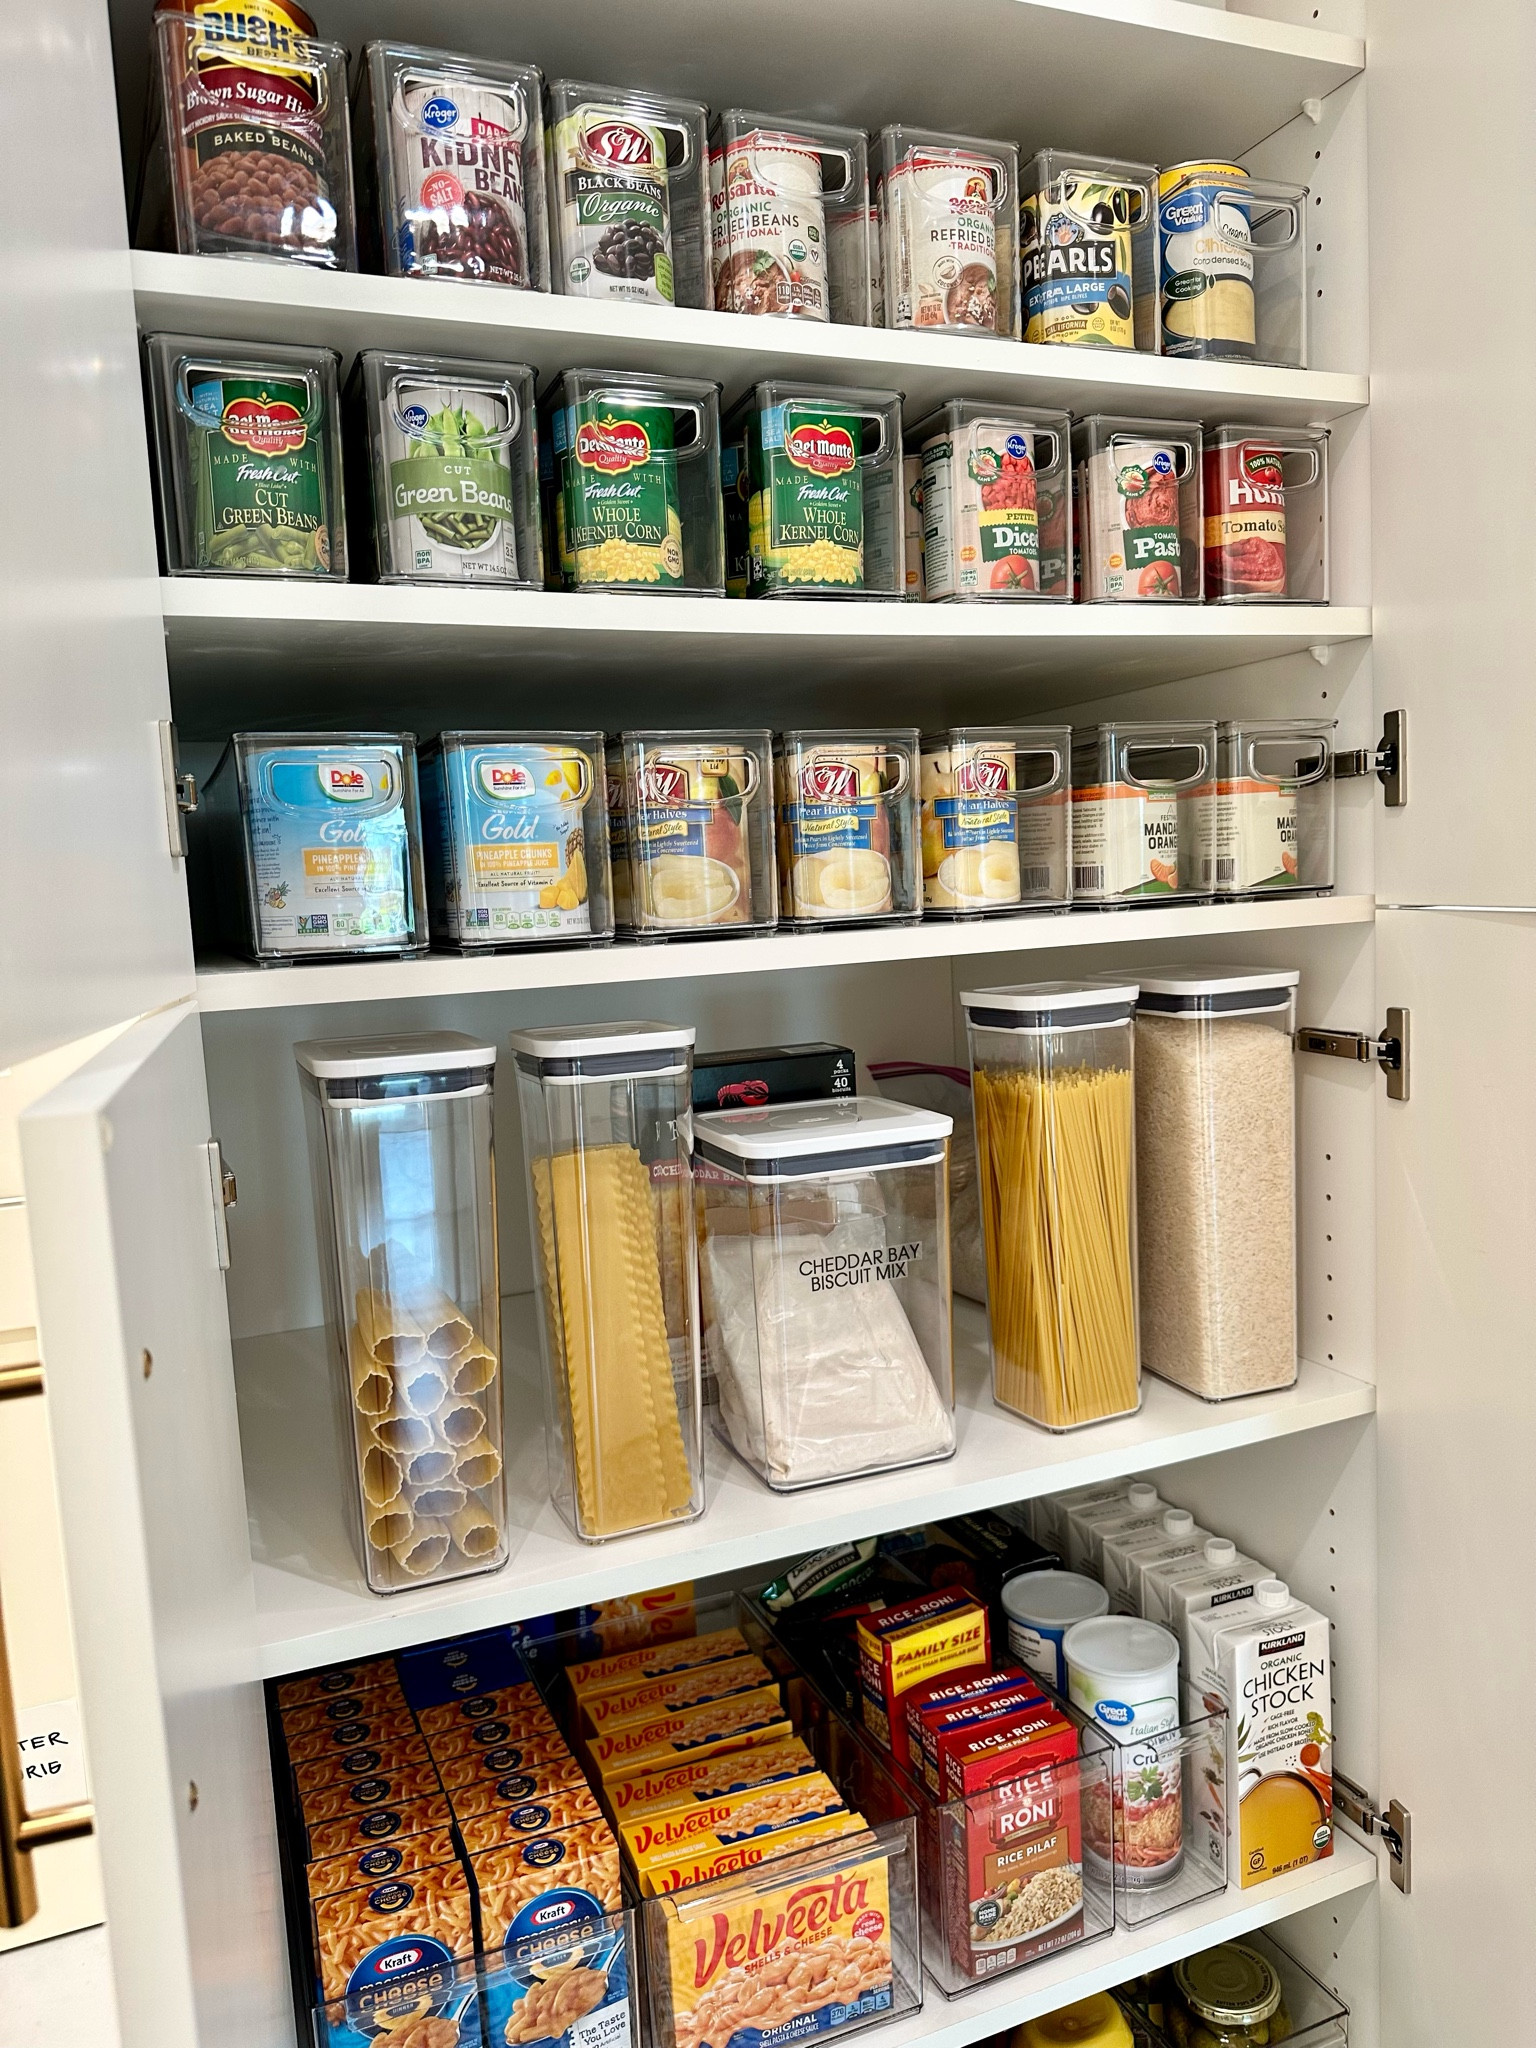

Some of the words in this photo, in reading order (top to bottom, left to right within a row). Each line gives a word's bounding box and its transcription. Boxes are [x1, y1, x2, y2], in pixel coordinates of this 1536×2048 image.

[236, 82, 284, 104] Sugar
[424, 103, 457, 124] Kroger
[214, 131, 266, 147] BAKED
[271, 134, 315, 166] BEANS
[420, 136, 522, 184] KIDNEY
[432, 179, 446, 190] NO
[577, 176, 623, 191] BLACK
[626, 180, 662, 201] BEANS
[430, 187, 454, 207] SALT
[582, 191, 660, 222] Organic
[1165, 201, 1204, 220] Great
[752, 213, 800, 228] BEANS
[930, 228, 985, 244] REFRIED
[1065, 282, 1106, 294] LARGE
[200, 403, 216, 412] SEA
[252, 434, 284, 447] Quality
[1007, 439, 1027, 456] Kroger
[817, 440, 852, 459] Monte
[213, 453, 249, 465] MADE
[289, 457, 317, 473] WITH
[598, 454, 628, 465] Quality
[236, 463, 273, 482] Fresh
[444, 465, 472, 476] CUT
[632, 472, 662, 485] WITH
[775, 476, 809, 487] MADE
[255, 488, 289, 508] CUT
[395, 482, 458, 508] Green
[460, 479, 513, 514] Beans
[584, 482, 616, 502] Fresh
[796, 484, 827, 502] Fresh
[222, 506, 274, 525] GREEN
[276, 507, 318, 530] BEANS
[592, 505, 642, 523] WHOLE
[803, 507, 848, 525] WHOLE
[1006, 512, 1035, 521] PETITE
[575, 523, 623, 544] KERNEL
[625, 521, 662, 541] CORN
[780, 523, 832, 541] KERNEL
[833, 523, 859, 545] CORN
[1222, 519, 1277, 534] Tomato
[416, 550, 432, 558] non
[416, 557, 432, 565] BPA
[462, 562, 477, 570] NET
[477, 562, 489, 571] WT
[709, 762, 719, 770] Lid
[331, 770, 364, 785] Dole
[492, 768, 526, 784] Dole
[653, 808, 688, 820] Halves
[823, 805, 859, 815] Halves
[983, 801, 1010, 810] Halves
[481, 814, 540, 841] Gold
[664, 821, 683, 835] Style
[836, 817, 856, 830] Style
[312, 854, 360, 865] PINEAPPLE
[476, 849, 518, 860] PINEAPPLE
[520, 848, 552, 859] CHUNKS
[316, 865, 324, 873] IN
[502, 860, 533, 868] PINEAPPLE
[534, 859, 549, 867] JUICE
[500, 880, 519, 888] Source
[527, 879, 549, 887] Vitamin
[336, 920, 345, 928] 80
[836, 1058, 844, 1070] 4
[833, 1076, 849, 1088] 40
[799, 1249, 884, 1276] CHEDDAR
[888, 1243, 920, 1263] BAY
[811, 1267, 872, 1292] BISCUIT
[876, 1261, 906, 1281] MIX
[1213, 1587, 1253, 1604] KIRKLAND
[878, 1608, 914, 1628] RICE
[920, 1595, 955, 1613] RONI
[895, 1637, 949, 1665] FAMILY
[951, 1625, 981, 1647] SIZE
[1260, 1633, 1305, 1651] KIRKLAND
[574, 1651, 657, 1685] Velveeta
[1260, 1652, 1303, 1671] ORGANIC
[929, 1684, 964, 1702] RICE
[972, 1672, 1009, 1689] RONI
[1242, 1658, 1325, 1699] CHICKEN
[960, 1687, 989, 1699] CHICKEN
[1251, 1681, 1315, 1718] STOCK
[593, 1684, 677, 1721] Velveeta
[945, 1705, 982, 1723] RICE
[989, 1692, 1027, 1710] RONI
[1098, 1703, 1128, 1716] Great
[978, 1707, 1007, 1720] CHICKEN
[1105, 1712, 1128, 1722] Value
[1269, 1708, 1295, 1721] CAGE-FREE
[1130, 1724, 1159, 1736] Italian
[1267, 1722, 1279, 1731] RICH
[1279, 1716, 1299, 1727] FLAVOR
[597, 1720, 686, 1761] Velveeta
[968, 1733, 1006, 1752] RICE
[1012, 1718, 1049, 1737] RONI
[1253, 1735, 1265, 1746] MADE
[1265, 1731, 1280, 1741] FROM
[1280, 1721, 1316, 1736] SLOW-COOKED
[1255, 1738, 1276, 1751] ORGANIC
[1276, 1732, 1297, 1743] CHICKEN
[997, 1741, 1013, 1751] RICE
[1013, 1735, 1031, 1746] PILAF
[1258, 1751, 1266, 1759] USE
[1266, 1744, 1286, 1755] INSTEAD
[945, 1750, 962, 1777] RICE
[945, 1762, 963, 1790] RONI
[997, 1764, 1055, 1803] RICE
[614, 1764, 709, 1809] Velveeta
[771, 1817, 801, 1830] ORIGINAL
[1000, 1798, 1054, 1834] RONI
[633, 1805, 732, 1855] Velveeta
[997, 1849, 1024, 1868] RICE
[1026, 1836, 1057, 1857] PILAF
[1252, 1857, 1262, 1866] GF
[1271, 1865, 1283, 1875] 946
[661, 1847, 764, 1894] Velveeta
[382, 1885, 398, 1894] Kraft
[539, 1905, 566, 1922] Kraft
[978, 1906, 997, 1916] HOME
[978, 1912, 997, 1921] MADE
[694, 1871, 870, 1989] Velveeta
[853, 1922, 883, 1937] cheese
[861, 1917, 876, 1928] real
[744, 1950, 781, 1975] SHELLS
[783, 1946, 791, 1957] &
[793, 1926, 834, 1953] CHEESE
[1038, 1942, 1047, 1952] NET
[1046, 1941, 1054, 1951] WT
[384, 1953, 413, 1970] Kraft
[831, 2007, 845, 2017] 370
[578, 2026, 597, 2040] The
[597, 2011, 626, 2030] Taste
[583, 2033, 602, 2046] You
[603, 2021, 626, 2038] Love
[762, 2014, 818, 2038] ORIGINAL
[759, 2037, 773, 2048] SHELL
[772, 2034, 786, 2046] PASTA
[789, 2027, 806, 2039] CHEESE
[805, 2022, 820, 2034] SAUCE
